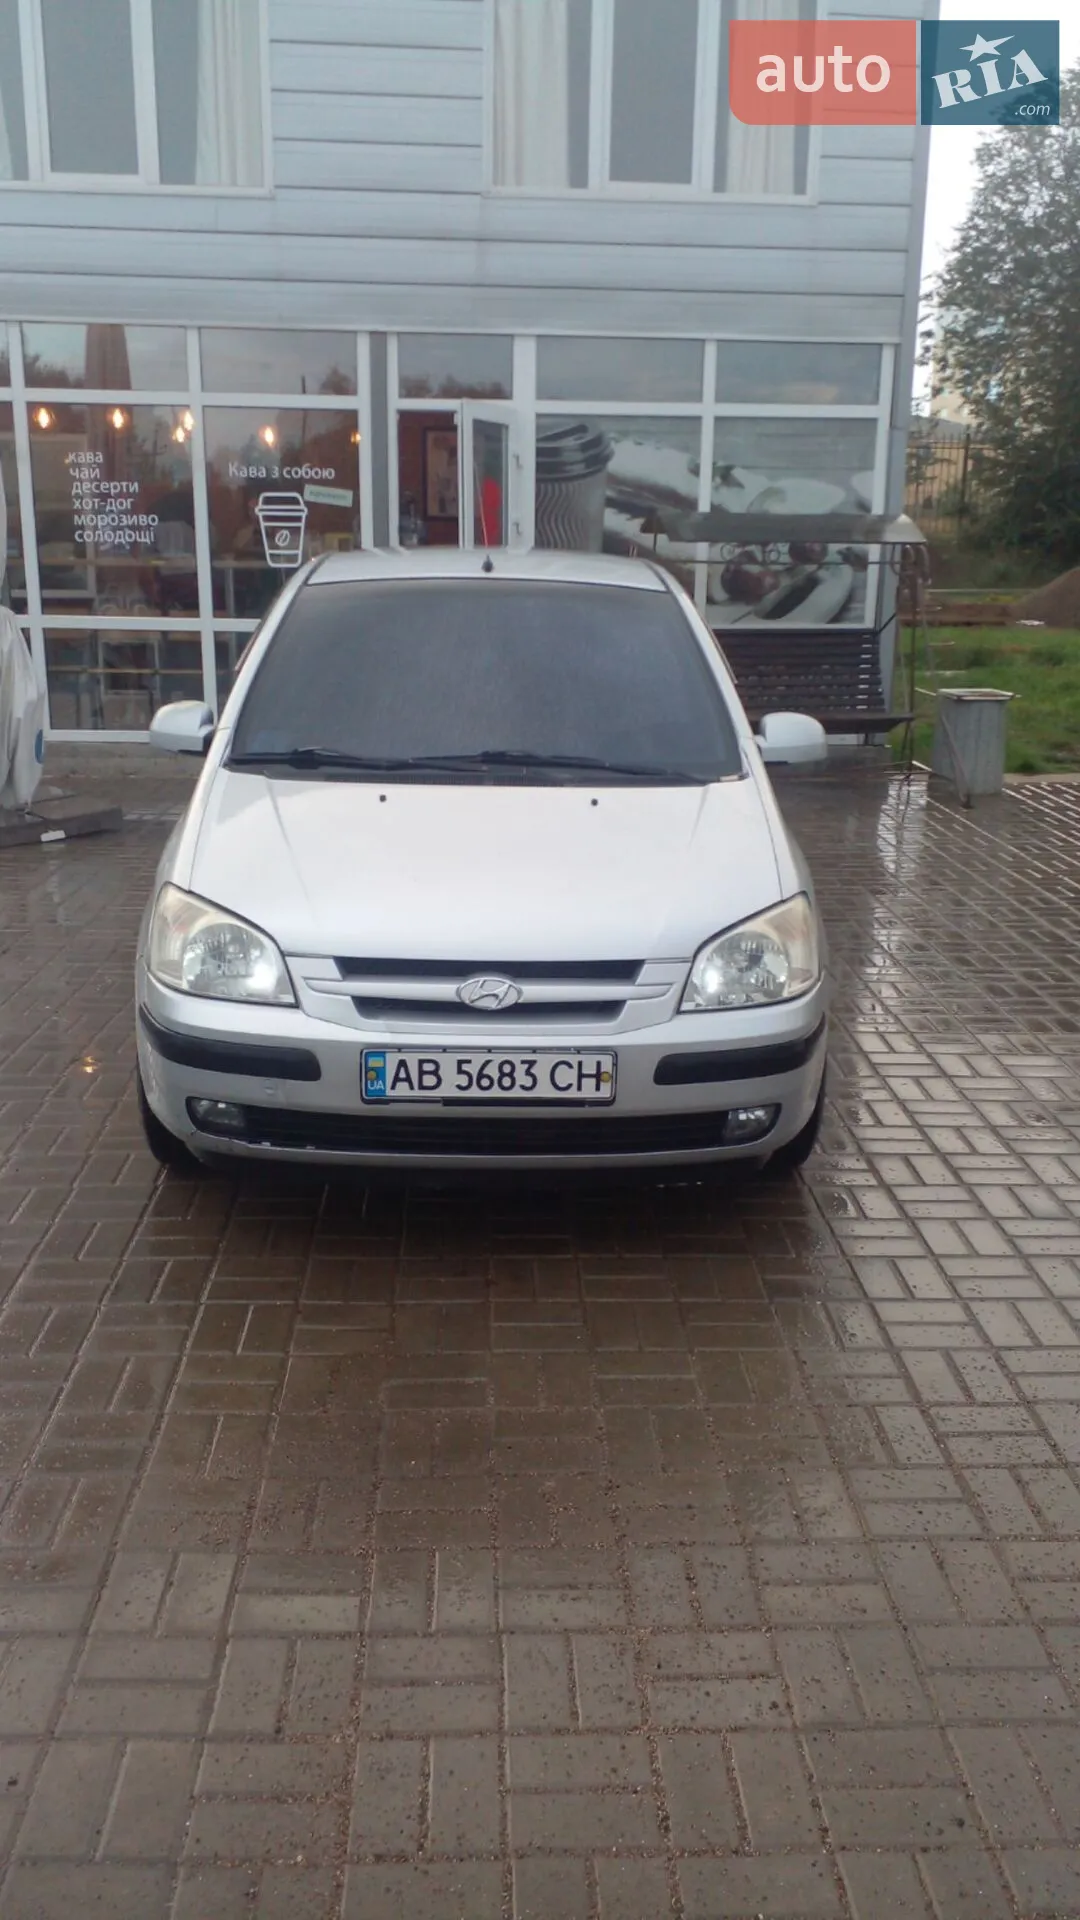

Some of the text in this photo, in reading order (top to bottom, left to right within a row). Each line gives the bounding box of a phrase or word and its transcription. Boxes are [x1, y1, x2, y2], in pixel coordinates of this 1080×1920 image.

[68, 451, 104, 463] кава
[69, 464, 100, 479] чай
[228, 461, 336, 479] Кава з собою
[71, 481, 139, 496] десерти
[73, 498, 135, 513] хот-дог
[73, 514, 159, 528] морозиво
[74, 527, 155, 544] солодощі
[390, 1058, 602, 1092] AB 5683 CH
[367, 1080, 385, 1091] UA
